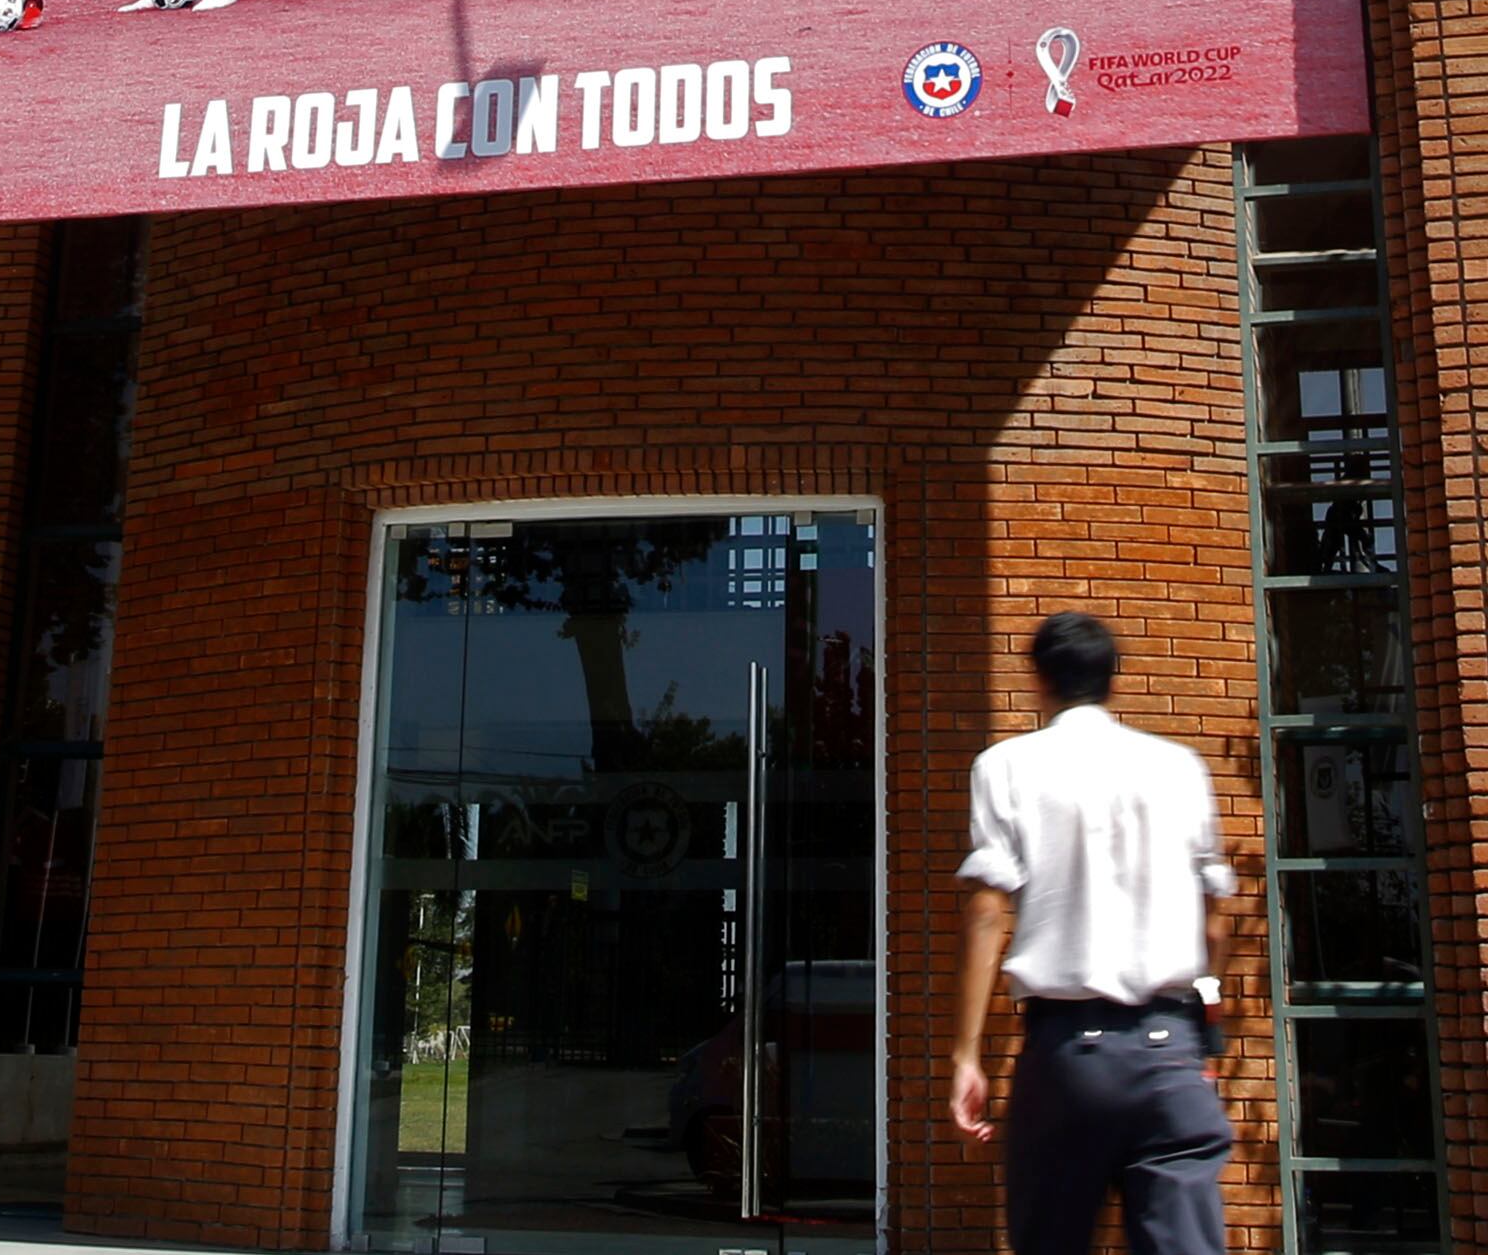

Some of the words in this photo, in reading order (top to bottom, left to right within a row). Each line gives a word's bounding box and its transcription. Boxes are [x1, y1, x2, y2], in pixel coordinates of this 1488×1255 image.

[1088, 55, 1129, 72] FIFA
[1131, 49, 1201, 68] WORLD
[1203, 45, 1242, 63] CUP
[158, 99, 233, 179] LA
[247, 86, 420, 173] ROJA
[435, 74, 559, 160] CON
[574, 55, 793, 150] TODOS
